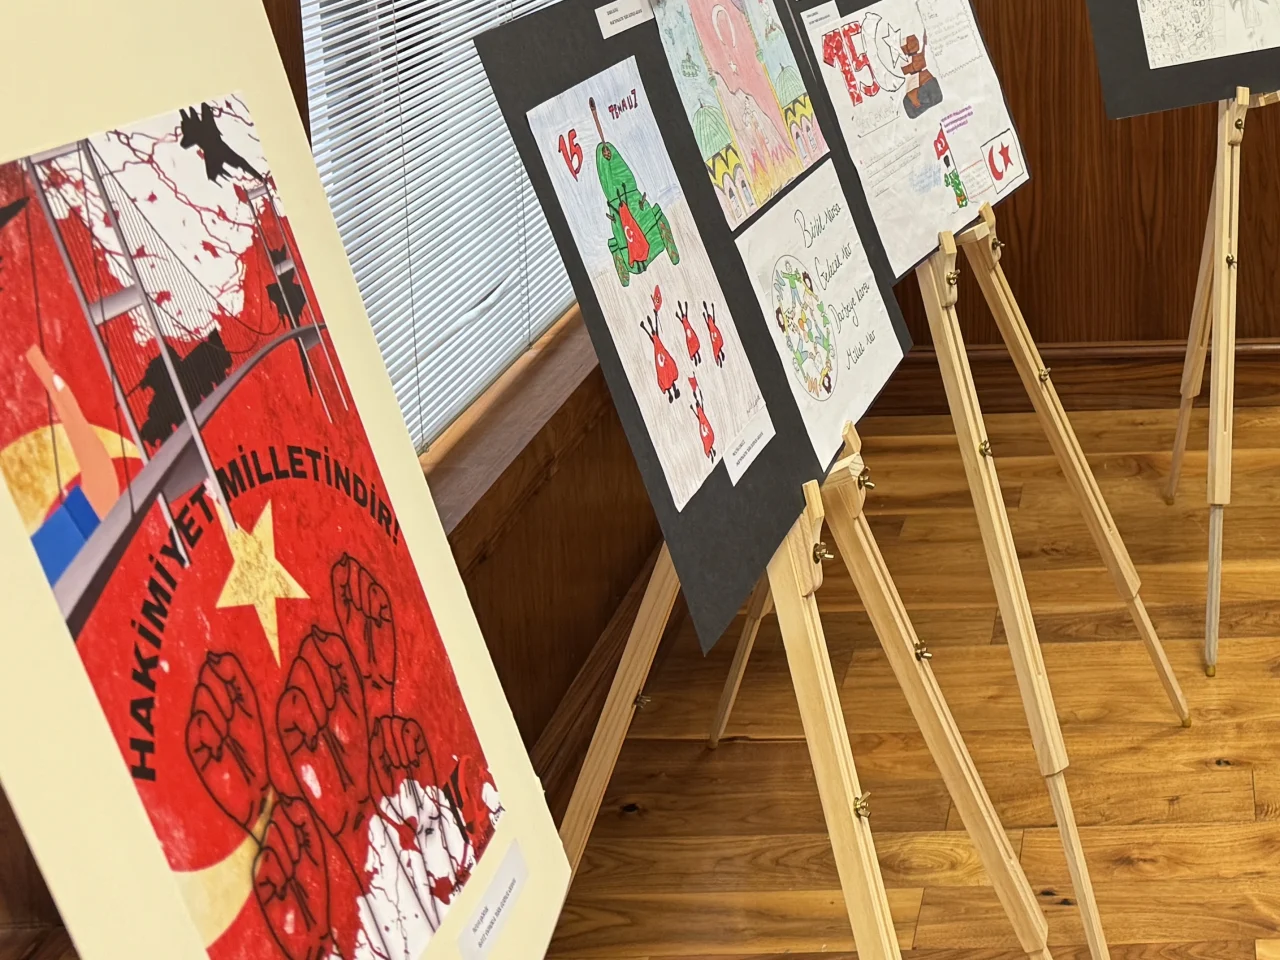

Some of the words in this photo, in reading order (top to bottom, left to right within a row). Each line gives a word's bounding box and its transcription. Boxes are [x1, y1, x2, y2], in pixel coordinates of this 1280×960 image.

[558, 128, 584, 182] 15
[130, 488, 215, 782] HAKİMİYET
[214, 444, 402, 547] MİLLETİNDİR!
